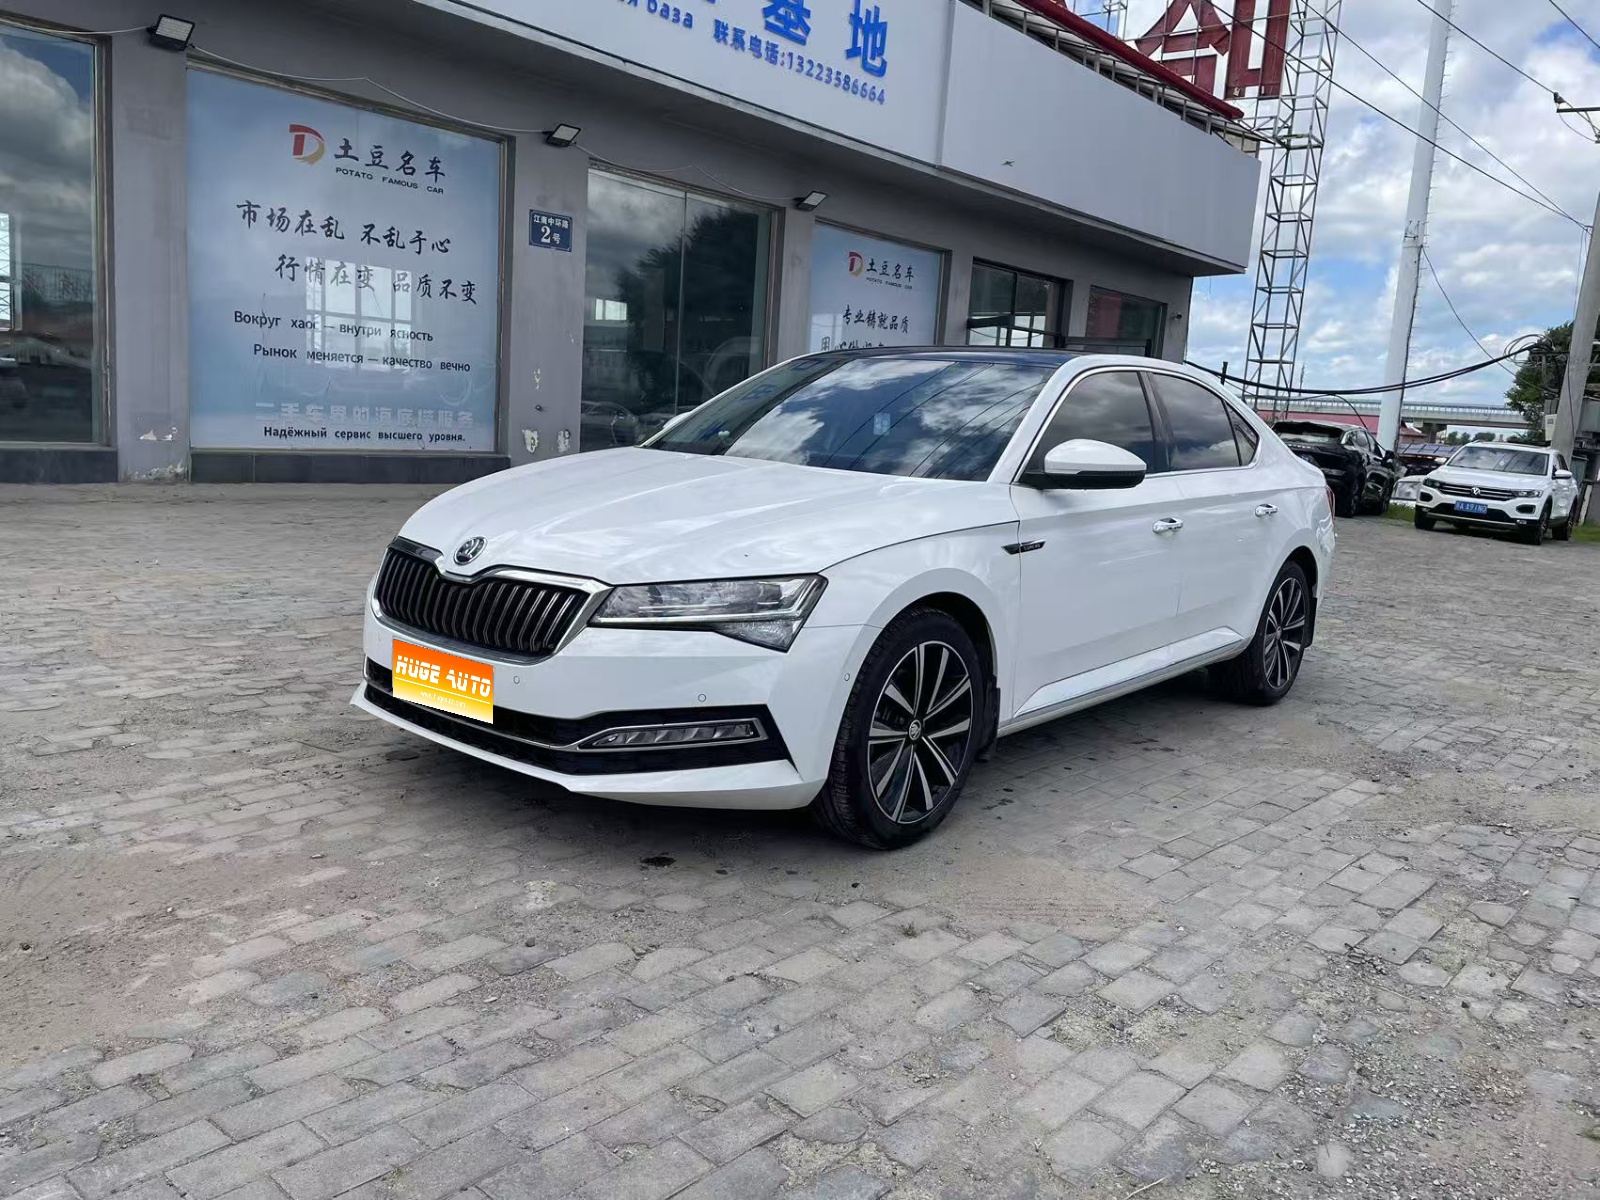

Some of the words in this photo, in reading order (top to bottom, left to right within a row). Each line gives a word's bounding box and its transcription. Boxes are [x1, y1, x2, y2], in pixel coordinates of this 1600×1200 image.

[334, 138, 445, 183] 土豆名车
[335, 167, 373, 180] POTATO
[382, 176, 418, 189] FAMOUS
[426, 185, 444, 195] CAR
[236, 200, 344, 240] 市场在乱
[360, 223, 451, 255] 不乱于心
[275, 254, 376, 292] 行情在变
[392, 272, 477, 305] 品质不变
[866, 258, 914, 282] 土豆名车
[233, 310, 282, 329] Вокруг
[290, 317, 320, 331] хаос
[339, 323, 382, 338] внутри
[389, 329, 434, 342] ясность
[253, 343, 298, 359] Рынок
[306, 350, 364, 364] меняется
[382, 356, 433, 370] качество
[440, 361, 471, 373] вечно
[263, 426, 327, 439] Надёжный
[334, 431, 371, 440] сервис
[378, 431, 423, 441] высшего
